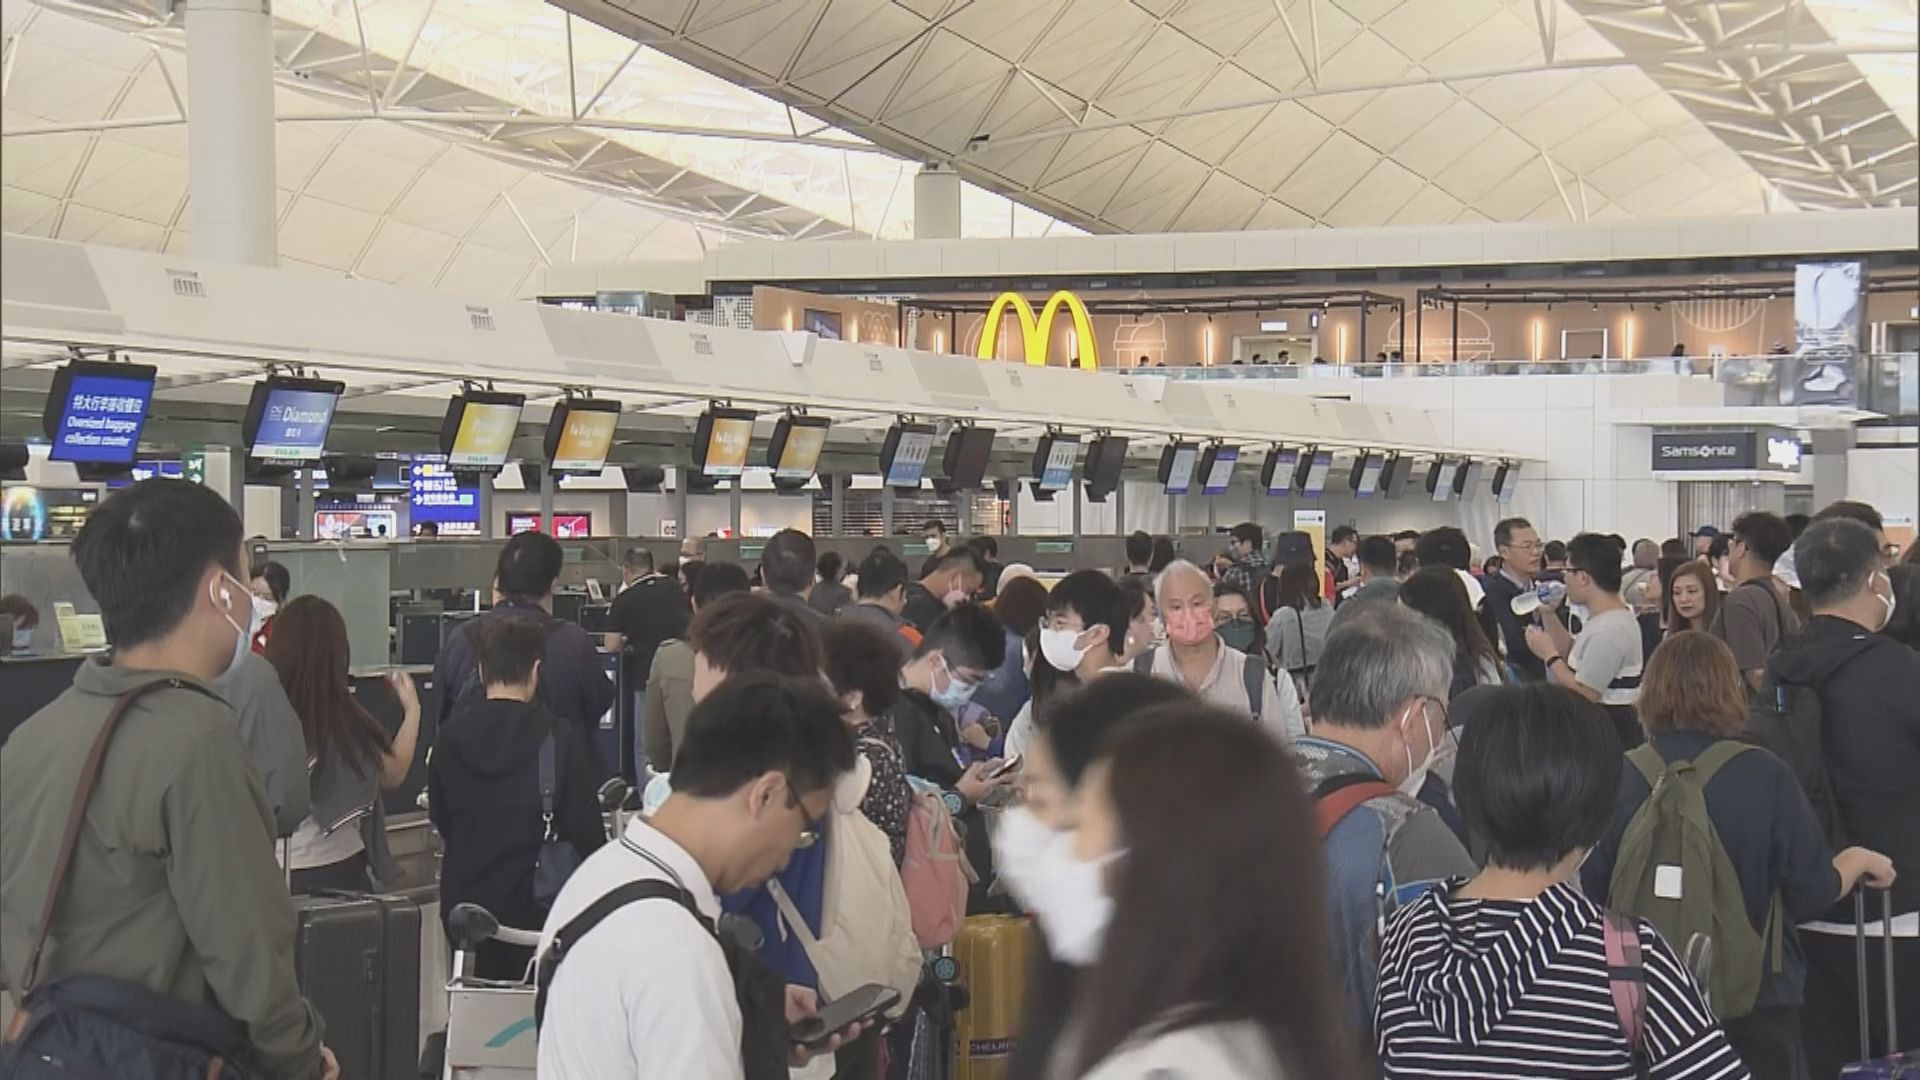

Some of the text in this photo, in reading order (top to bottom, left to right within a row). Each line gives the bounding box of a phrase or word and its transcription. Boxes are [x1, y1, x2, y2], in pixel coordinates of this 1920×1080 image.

[283, 406, 329, 423] Diamond
[67, 416, 137, 433] Oversized baggage
[64, 432, 131, 447] collection counter
[1661, 445, 1737, 458] Samsonite
